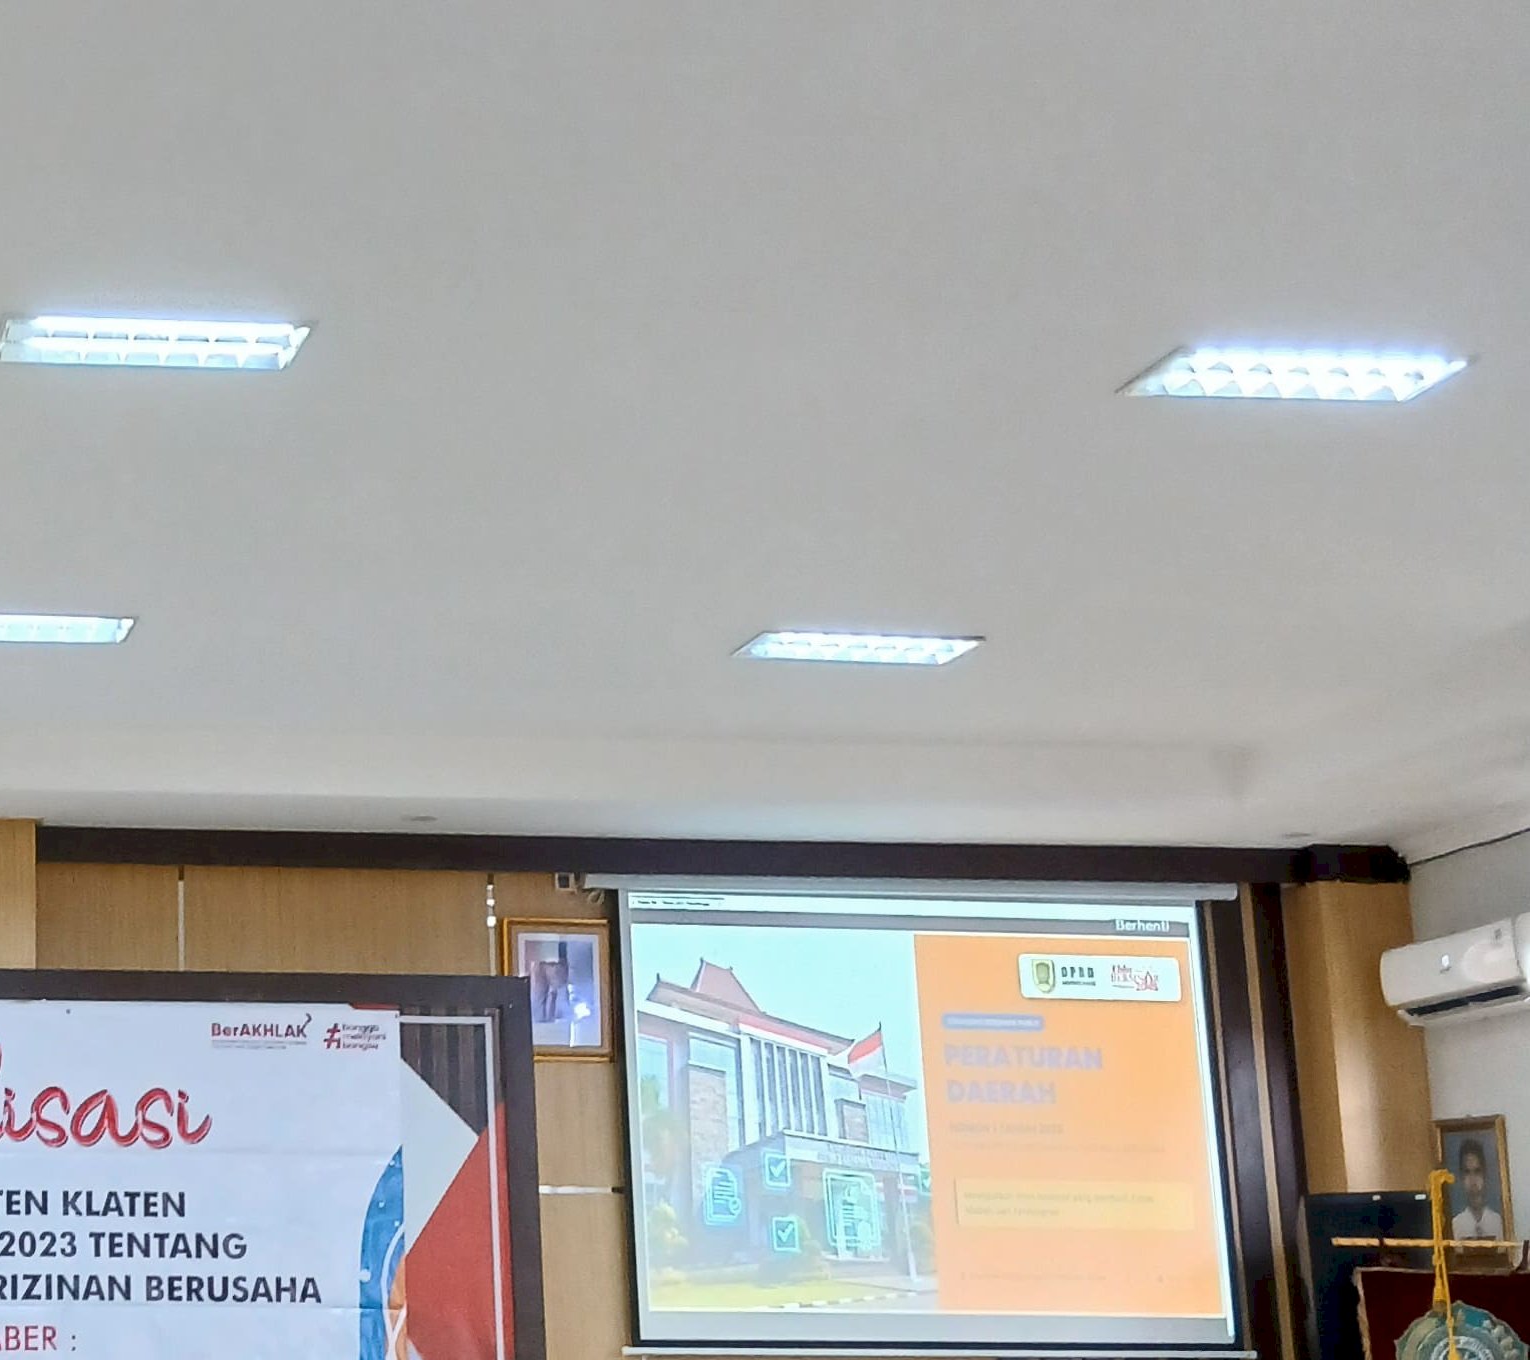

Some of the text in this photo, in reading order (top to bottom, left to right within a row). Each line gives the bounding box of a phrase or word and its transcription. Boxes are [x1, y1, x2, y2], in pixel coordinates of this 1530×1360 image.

[211, 1013, 313, 1039] BerAKHLAK
[946, 1079, 1057, 1105] DAERAH
[62, 1190, 186, 1218] KLATEN
[88, 1231, 248, 1260] TENTANG
[145, 1275, 322, 1305] BERUSAHA
